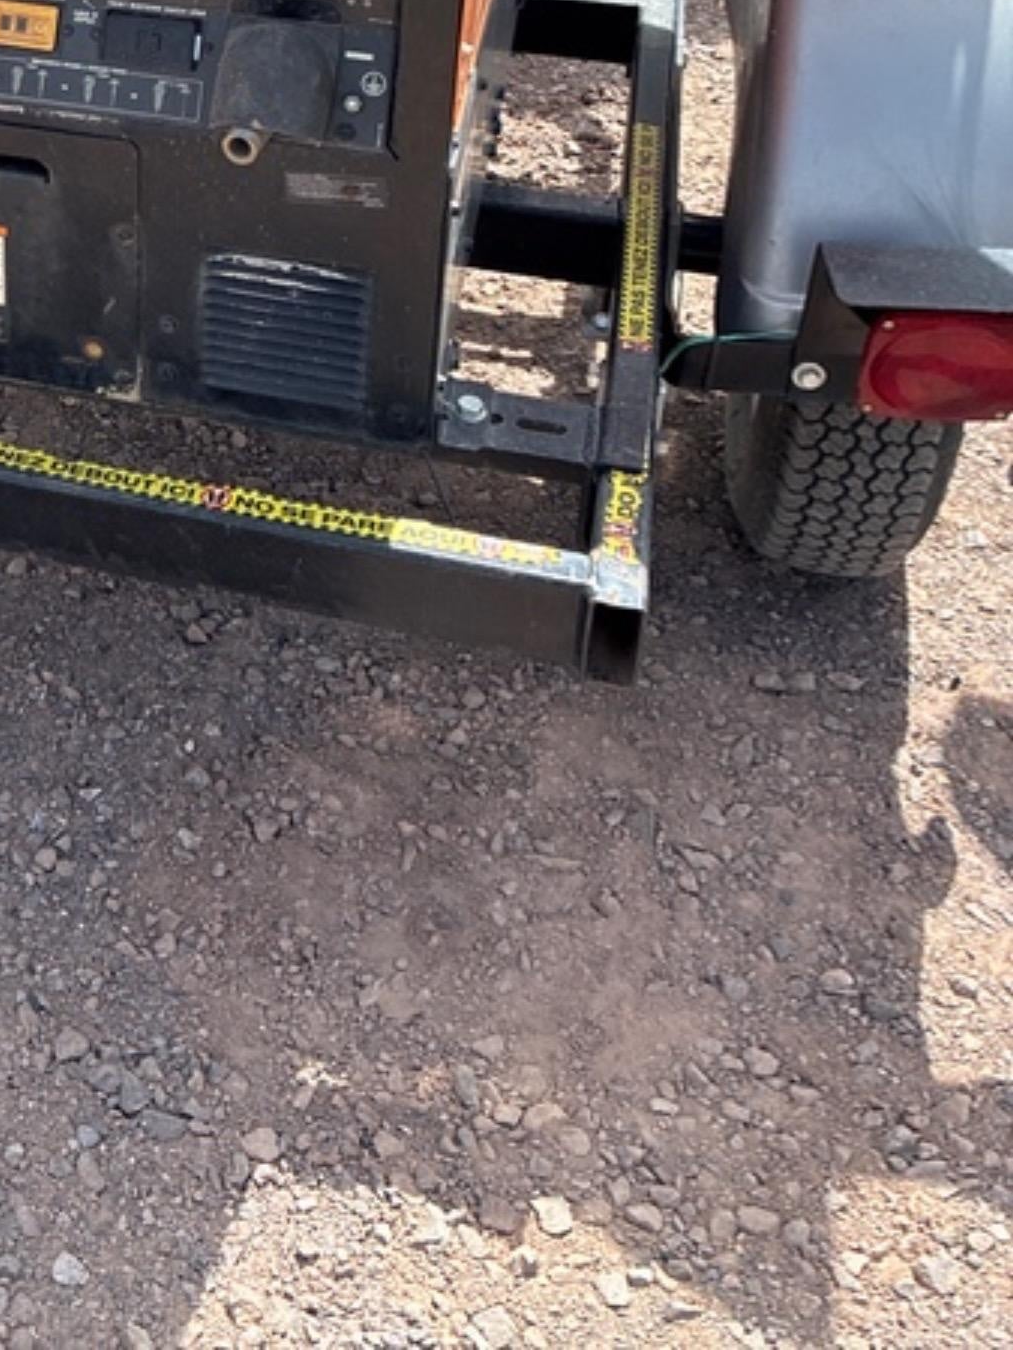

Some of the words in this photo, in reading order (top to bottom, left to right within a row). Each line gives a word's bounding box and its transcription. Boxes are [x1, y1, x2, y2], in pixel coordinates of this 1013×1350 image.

[50, 459, 156, 491] DEBOUT
[160, 480, 196, 498] ICI
[234, 493, 275, 514] NO
[280, 504, 317, 521] SE
